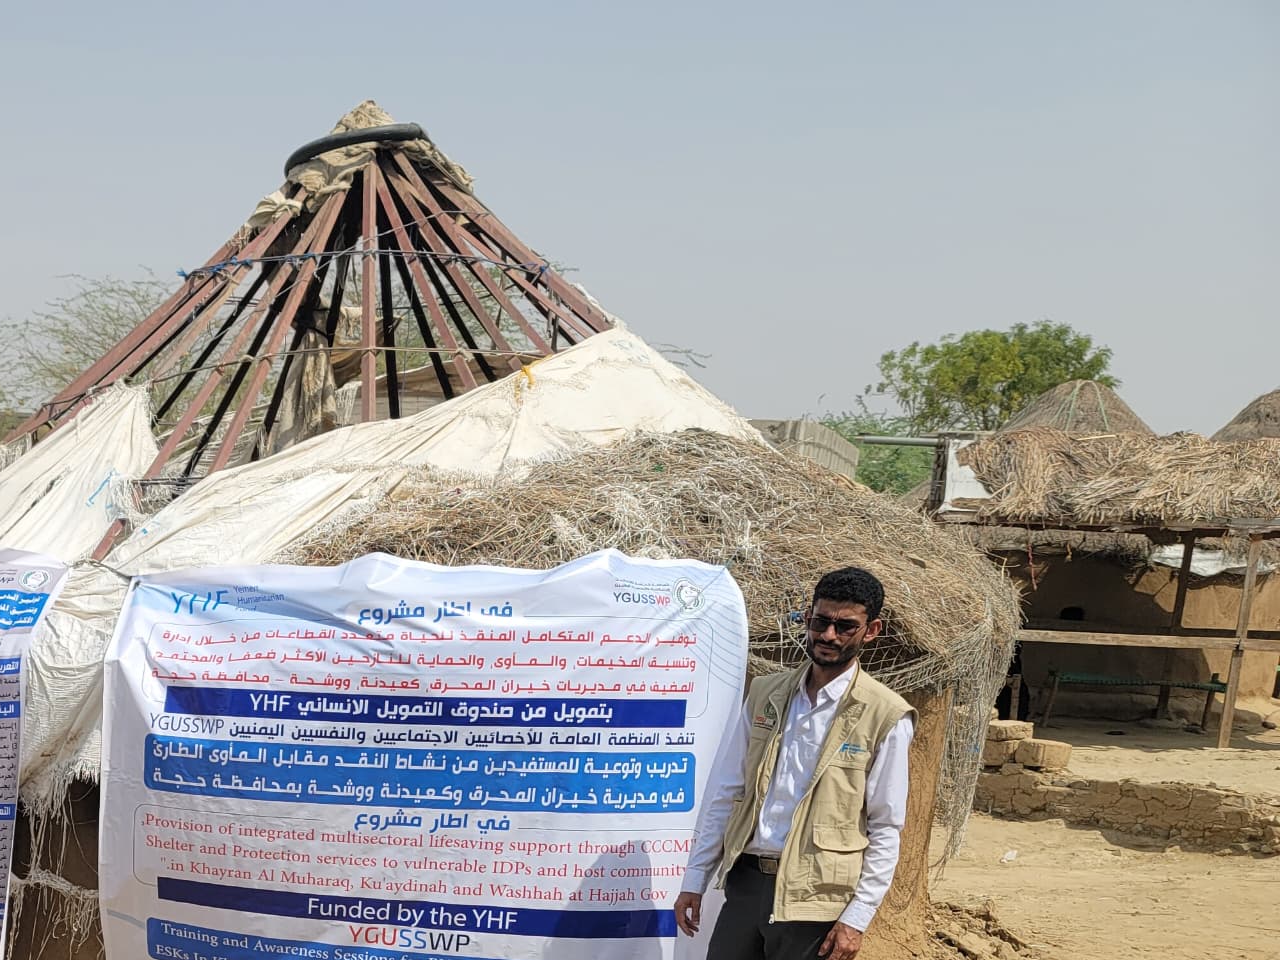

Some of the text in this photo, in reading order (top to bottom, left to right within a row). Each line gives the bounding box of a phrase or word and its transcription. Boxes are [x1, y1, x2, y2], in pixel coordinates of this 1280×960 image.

[171, 590, 230, 614] YHF
[613, 592, 671, 606] YGUSSWP
[357, 600, 425, 625] مشروع
[195, 632, 236, 646] خلال
[241, 631, 260, 644] من
[265, 629, 335, 640] القطاعات
[460, 630, 516, 641] المنقذ
[522, 631, 594, 643] المتكامل
[600, 632, 651, 645] الدعم
[655, 633, 697, 646] توفير
[153, 651, 223, 664] والمجتمع
[228, 650, 277, 662] ضعفا
[332, 652, 412, 668] للنازحين
[418, 653, 484, 668] والحماية
[648, 657, 696, 671] وتنسيق
[151, 667, 196, 684] حجة
[202, 672, 270, 684] محافظة
[290, 674, 350, 690] ووشحة
[502, 680, 550, 695] خيران
[557, 681, 620, 695] مديريات
[625, 683, 647, 695] في
[650, 681, 694, 693] المضيف
[250, 694, 613, 723] بتمويل من صندوق التمويل الانساني YHF
[150, 712, 224, 735] YGUSSWP
[229, 723, 284, 740] اليمنيين
[291, 727, 366, 744] والنفسيين
[373, 729, 458, 747] الاجتماعيين
[550, 732, 601, 745] العامة
[608, 732, 659, 746] المنظمة
[665, 732, 696, 746] تنفذ
[209, 743, 266, 766] المأوى
[273, 750, 328, 768] مقابل
[335, 753, 389, 769] النقد
[395, 752, 446, 772] نشاط
[452, 759, 478, 775] من
[484, 758, 580, 776] للمستفيدين
[584, 758, 642, 779] وتوعية
[646, 758, 687, 778] تدريب
[153, 767, 685, 810] في مديرية خيران المحرق وكعيدنة ووشحة بمحافظة حجة
[354, 809, 510, 834] في اطار مشروع
[219, 822, 235, 835] of
[238, 824, 315, 843] integrated
[321, 830, 423, 848] multisectoral
[429, 834, 504, 854] lifesaving
[510, 840, 572, 857] support
[578, 841, 635, 858] through
[145, 835, 194, 851] Shelter
[199, 843, 227, 856] and
[232, 845, 311, 864] Protection
[316, 853, 377, 868] services
[383, 857, 398, 869] to
[404, 858, 487, 874] vulnerable
[492, 861, 532, 876] IDPs
[537, 863, 567, 878] and
[573, 864, 606, 878] host
[190, 861, 251, 880] Khayran
[258, 869, 274, 882] Al
[281, 872, 354, 891] Muharaq,
[361, 876, 447, 895] Ku'aydinah
[453, 883, 483, 898] and
[490, 884, 563, 901] Washhah
[568, 889, 583, 901] at
[589, 889, 635, 906] Hajjah
[640, 887, 668, 901] Gov
[308, 898, 518, 930] Funded by the YHF
[160, 922, 218, 946] Training
[222, 934, 249, 949] and
[253, 939, 329, 960] Awareness
[349, 925, 470, 952] YGUSSWP
[156, 944, 189, 960] ESKs
